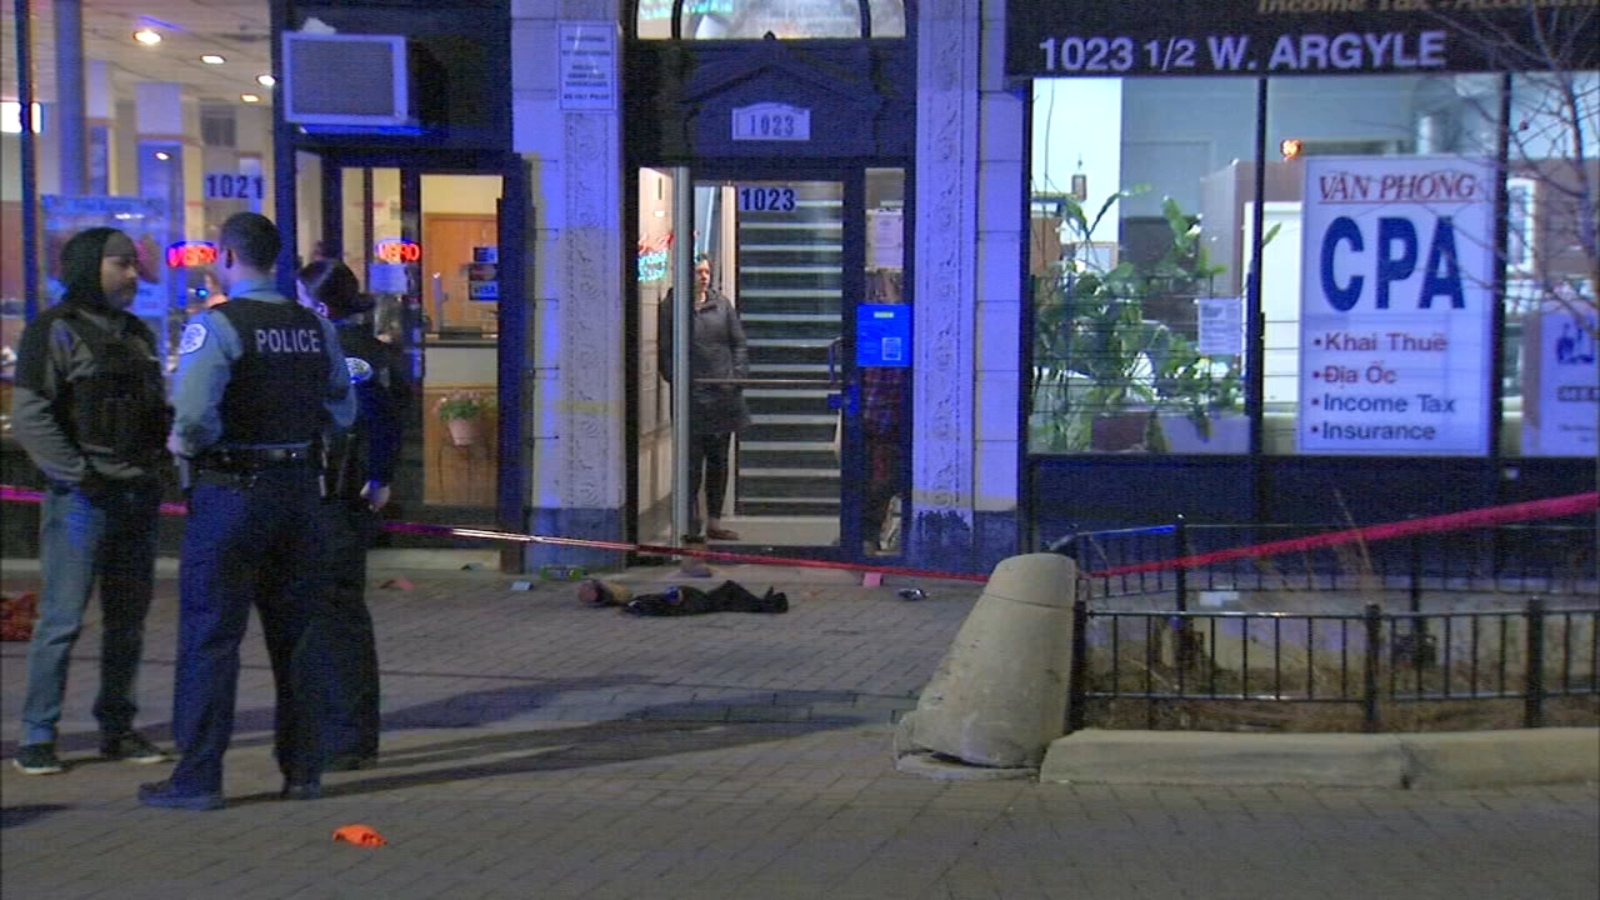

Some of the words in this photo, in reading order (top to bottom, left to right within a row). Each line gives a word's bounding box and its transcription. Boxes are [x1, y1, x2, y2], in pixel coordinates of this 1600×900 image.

[1039, 36, 1134, 71] 1023
[1143, 37, 1196, 71] 1/2
[1207, 36, 1257, 70] W.
[1268, 30, 1447, 70] ARGYLE
[750, 114, 795, 137] 1023
[207, 174, 263, 199] 1021
[741, 188, 795, 211] 1023
[1319, 216, 1466, 312] CPA
[255, 328, 321, 353] POLICE
[1325, 332, 1378, 351] Khai
[1323, 393, 1409, 413] Income
[1416, 394, 1456, 413] Tax
[1322, 422, 1436, 440] Insurance
